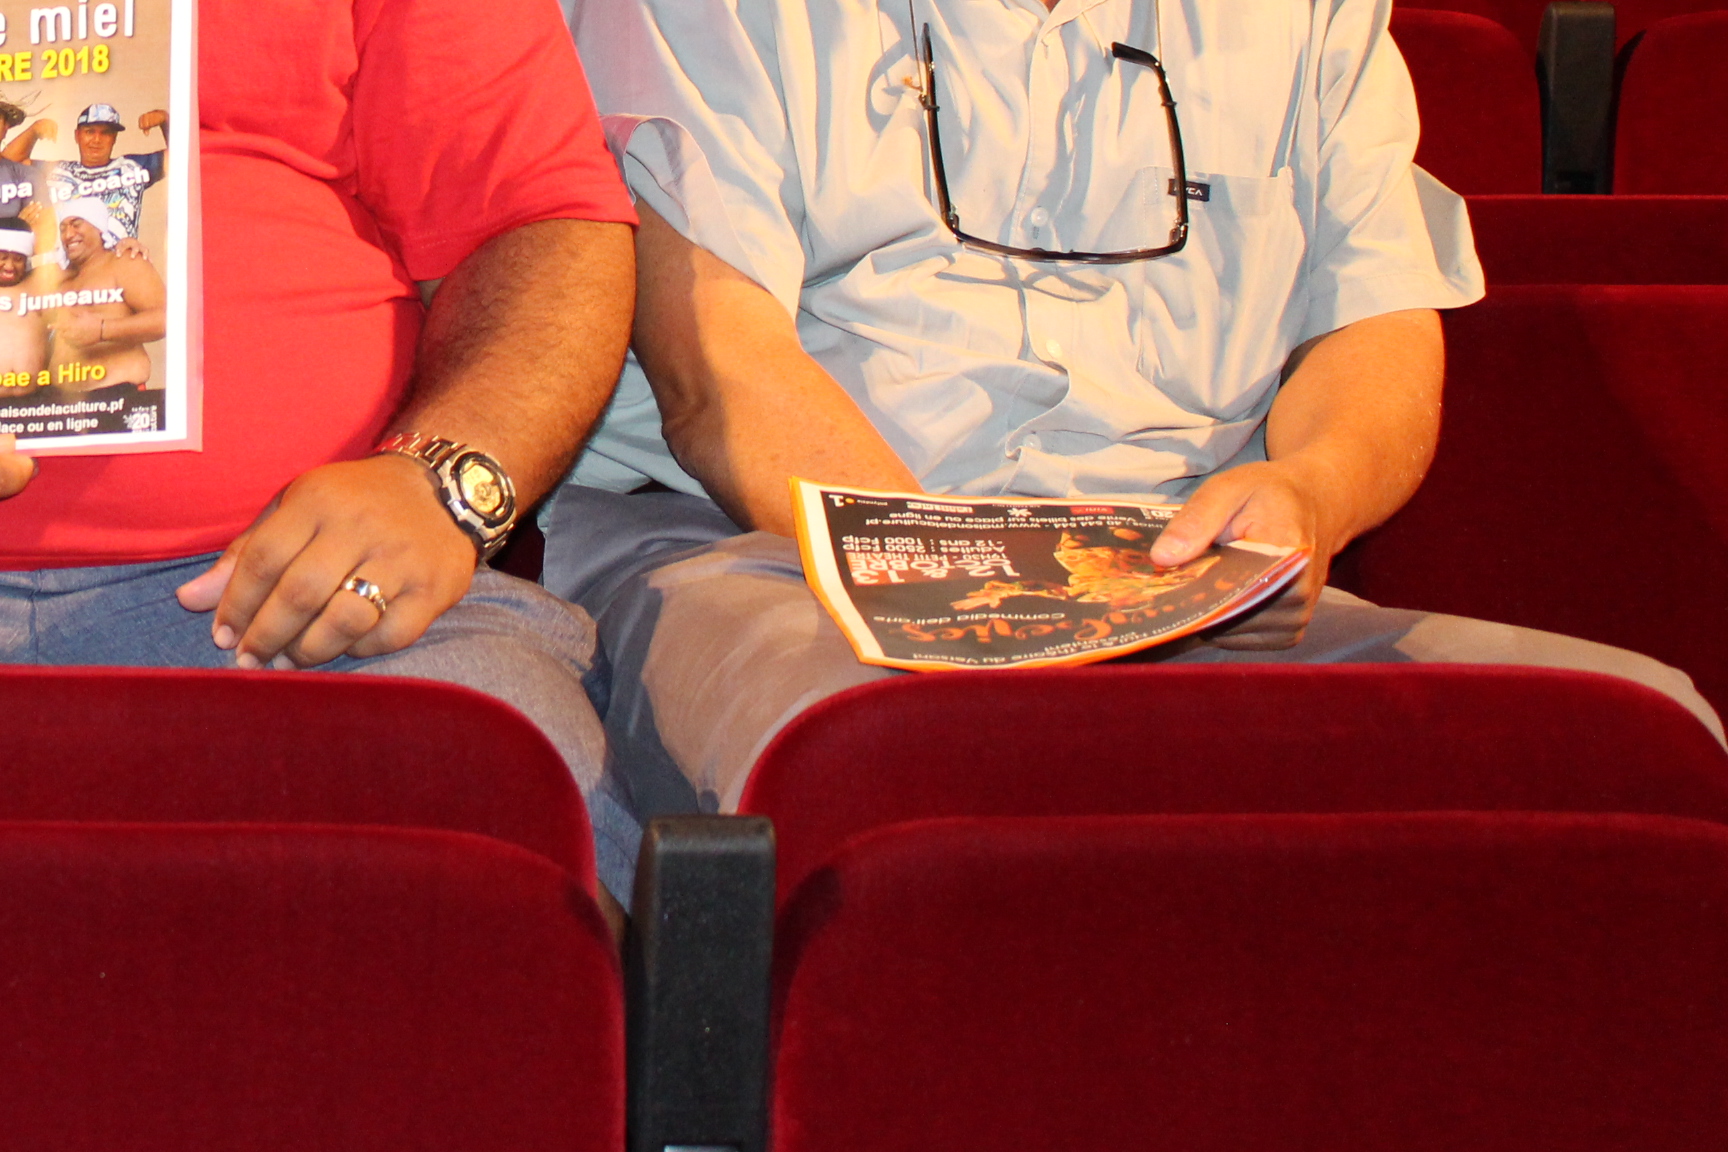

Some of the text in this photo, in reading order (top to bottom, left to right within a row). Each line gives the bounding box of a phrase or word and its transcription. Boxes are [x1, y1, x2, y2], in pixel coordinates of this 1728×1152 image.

[40, 44, 110, 79] 2018
[50, 183, 72, 203] le
[78, 168, 150, 196] coach
[18, 286, 124, 315] jumeaux
[37, 371, 51, 386] a
[58, 362, 106, 383] Hiro
[27, 421, 43, 432] ou
[47, 421, 63, 431] en
[66, 418, 98, 433] ligne
[132, 413, 150, 430] 20
[889, 512, 922, 520] ligne
[964, 515, 1004, 524] place
[1071, 515, 1090, 523] des
[885, 537, 923, 545] 1000
[885, 544, 925, 553] 2500
[940, 546, 1006, 554] Adultes
[912, 553, 949, 561] PETIT
[849, 558, 1011, 571] OCTOBRE
[851, 564, 1020, 584] 12 & 13
